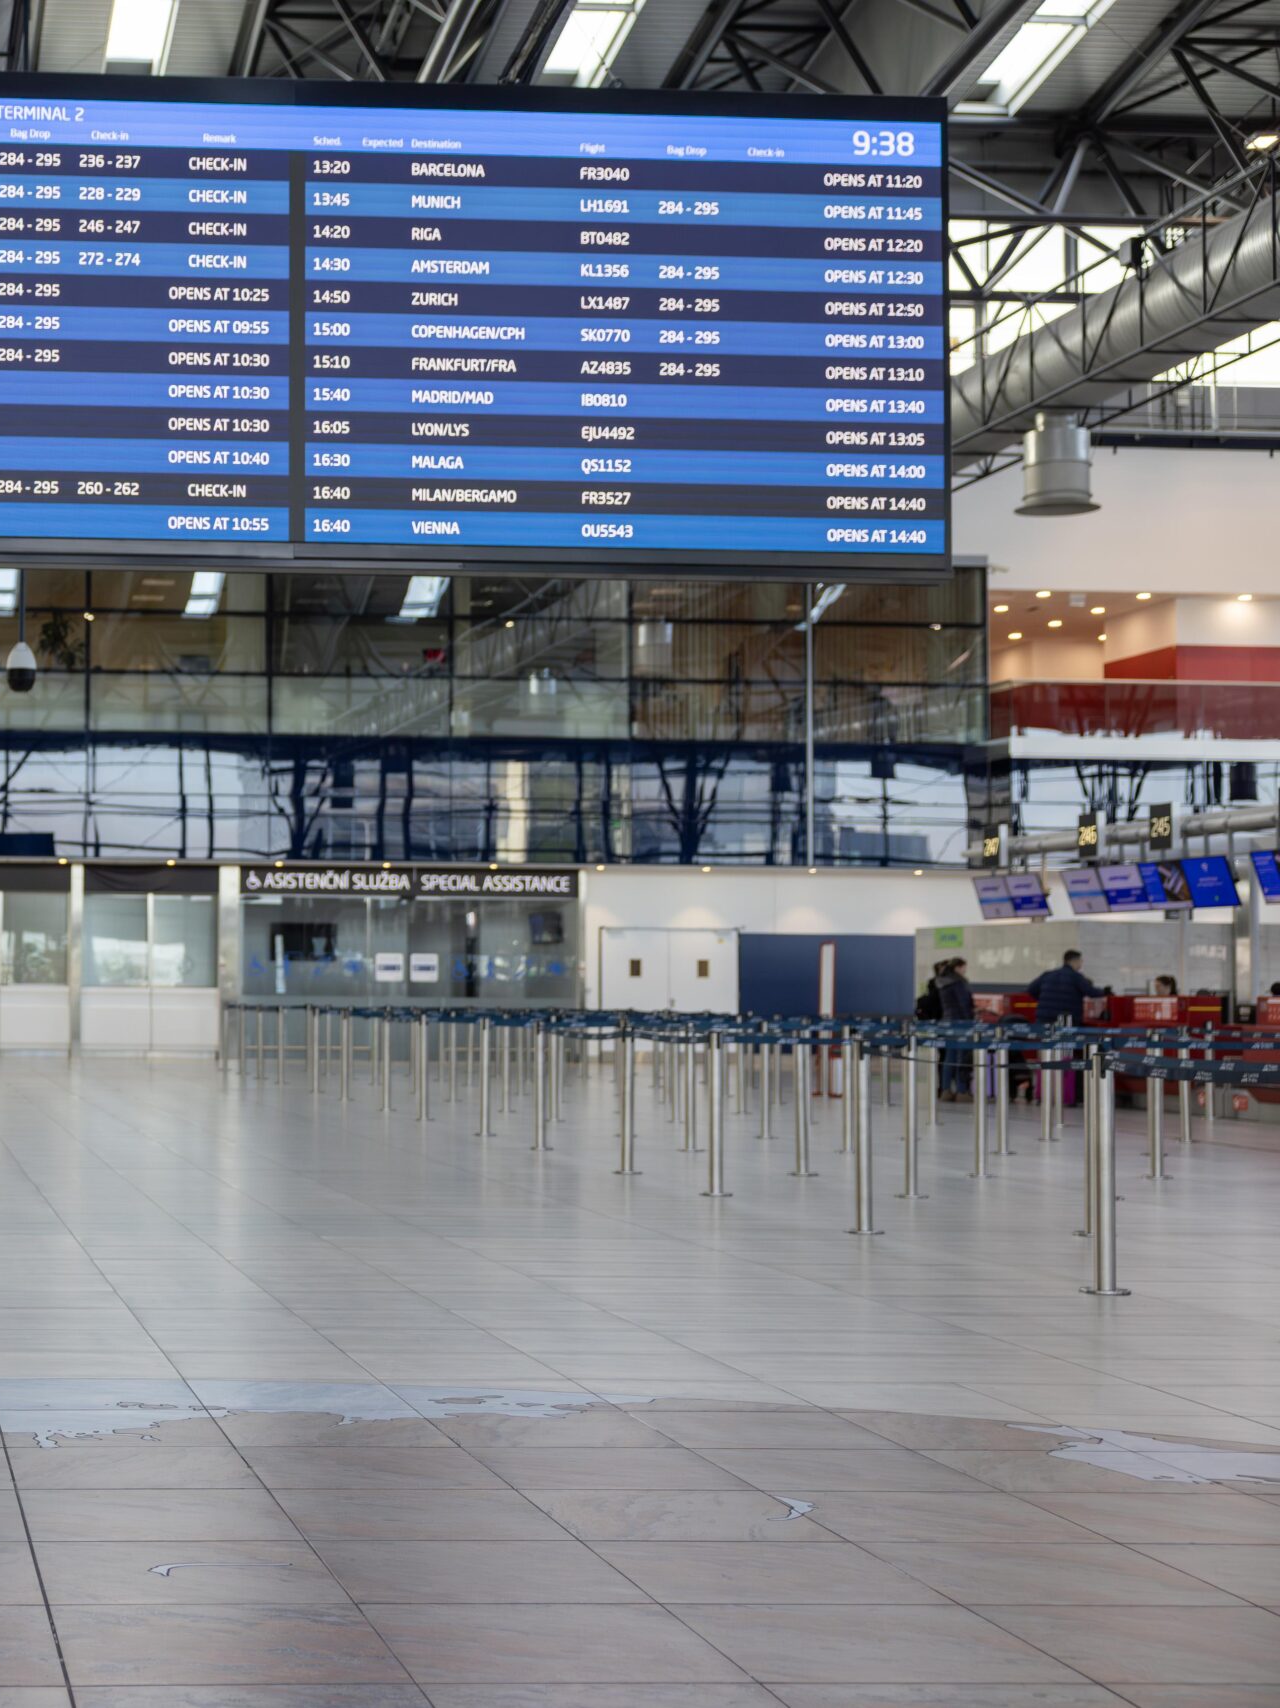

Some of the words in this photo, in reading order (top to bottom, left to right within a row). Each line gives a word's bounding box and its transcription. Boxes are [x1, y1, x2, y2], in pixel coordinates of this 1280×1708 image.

[74, 107, 85, 121] 2
[361, 136, 404, 149] Expected
[410, 137, 462, 150] Destination
[852, 129, 915, 157] 9:38
[313, 159, 351, 175] 13:20
[411, 162, 486, 178] BARCELONA
[579, 166, 630, 182] FR3040
[823, 172, 866, 189] OPENS
[867, 172, 884, 189] AT
[886, 172, 923, 189] 11:20
[313, 191, 350, 207] 13:45
[411, 194, 462, 210] MUNICH
[579, 198, 629, 214] LH1691
[313, 224, 351, 239] 14:20
[411, 226, 442, 242] RIGA
[580, 230, 630, 246] BT0482
[313, 256, 351, 272] 14:30
[411, 259, 490, 275] AMSTERDAM
[580, 263, 630, 278] KL1356
[313, 289, 351, 304] 14:50
[411, 291, 459, 307] ZURICH
[580, 295, 631, 311] LX1487
[313, 321, 351, 337] 15:00
[411, 324, 526, 341] COPENHAGEN/CPH
[580, 327, 631, 343] SK0770
[313, 354, 351, 369] 15:10
[411, 356, 517, 373] FRANKFURT/FRA
[580, 360, 632, 376] AZ4835
[313, 387, 351, 402] 15:40
[411, 389, 494, 405] MADRID/MAD
[581, 392, 628, 408] IB0810
[313, 419, 351, 435] 16:05
[411, 422, 470, 437] LYON/LYS
[581, 425, 635, 443] EJU4492
[313, 452, 351, 468] 16:30
[411, 454, 465, 470] MALAGA
[580, 458, 632, 475] QS1152
[313, 485, 351, 500] 16:40
[411, 487, 518, 504] MILAN/BERGAMO
[581, 490, 632, 506] FR3527
[167, 515, 211, 532] OPENS
[212, 515, 230, 532] AT
[232, 515, 270, 532] 10:55
[313, 518, 351, 533] 16:40
[411, 520, 461, 535] VIENNA
[1078, 824, 1098, 846] 246
[1150, 815, 1171, 838] 245
[263, 870, 350, 890] ASISTENČNÍ
[352, 870, 411, 891] SLUŽBA
[420, 873, 480, 891] SPECIAL
[482, 874, 571, 893] ASSISTANCE
